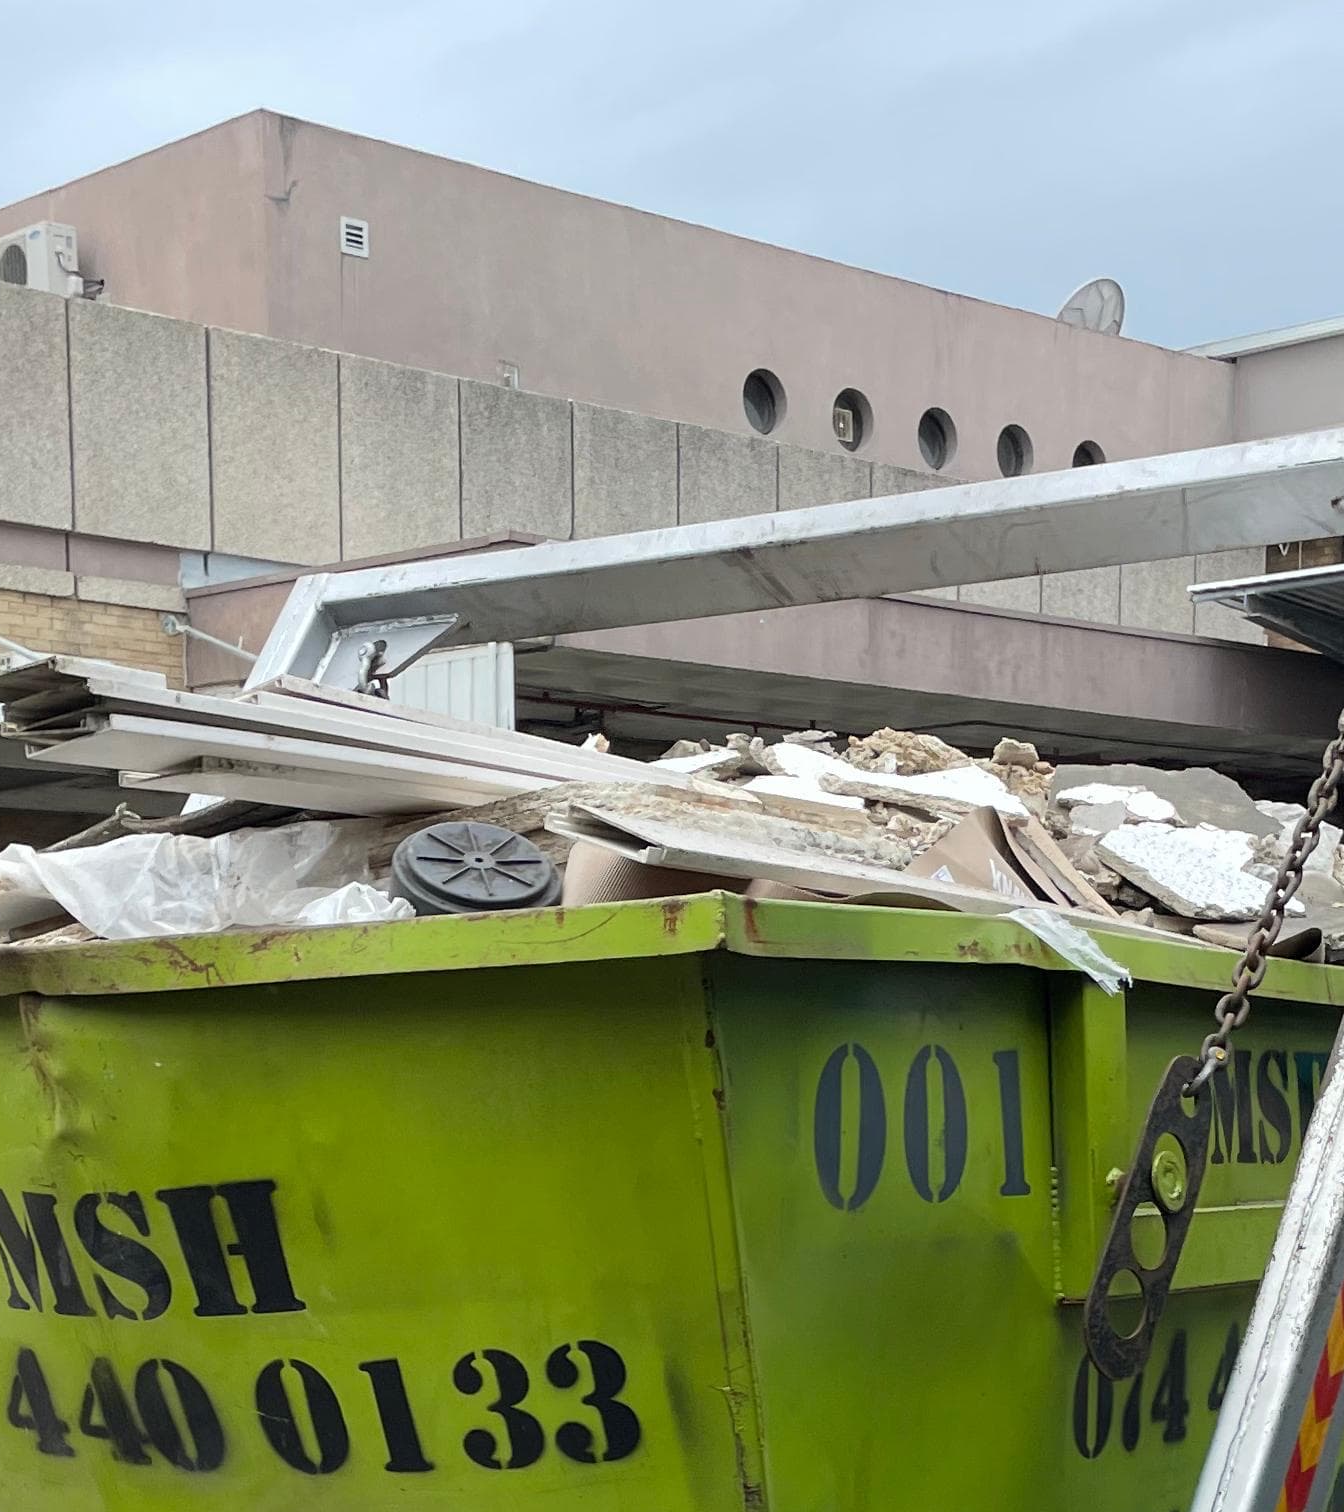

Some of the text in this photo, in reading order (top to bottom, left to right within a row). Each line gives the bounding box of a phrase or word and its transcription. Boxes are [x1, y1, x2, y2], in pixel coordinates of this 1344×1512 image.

[813, 1043, 1032, 1212] 001
[8, 1345, 226, 1473] 440
[256, 1339, 643, 1475] 0133
